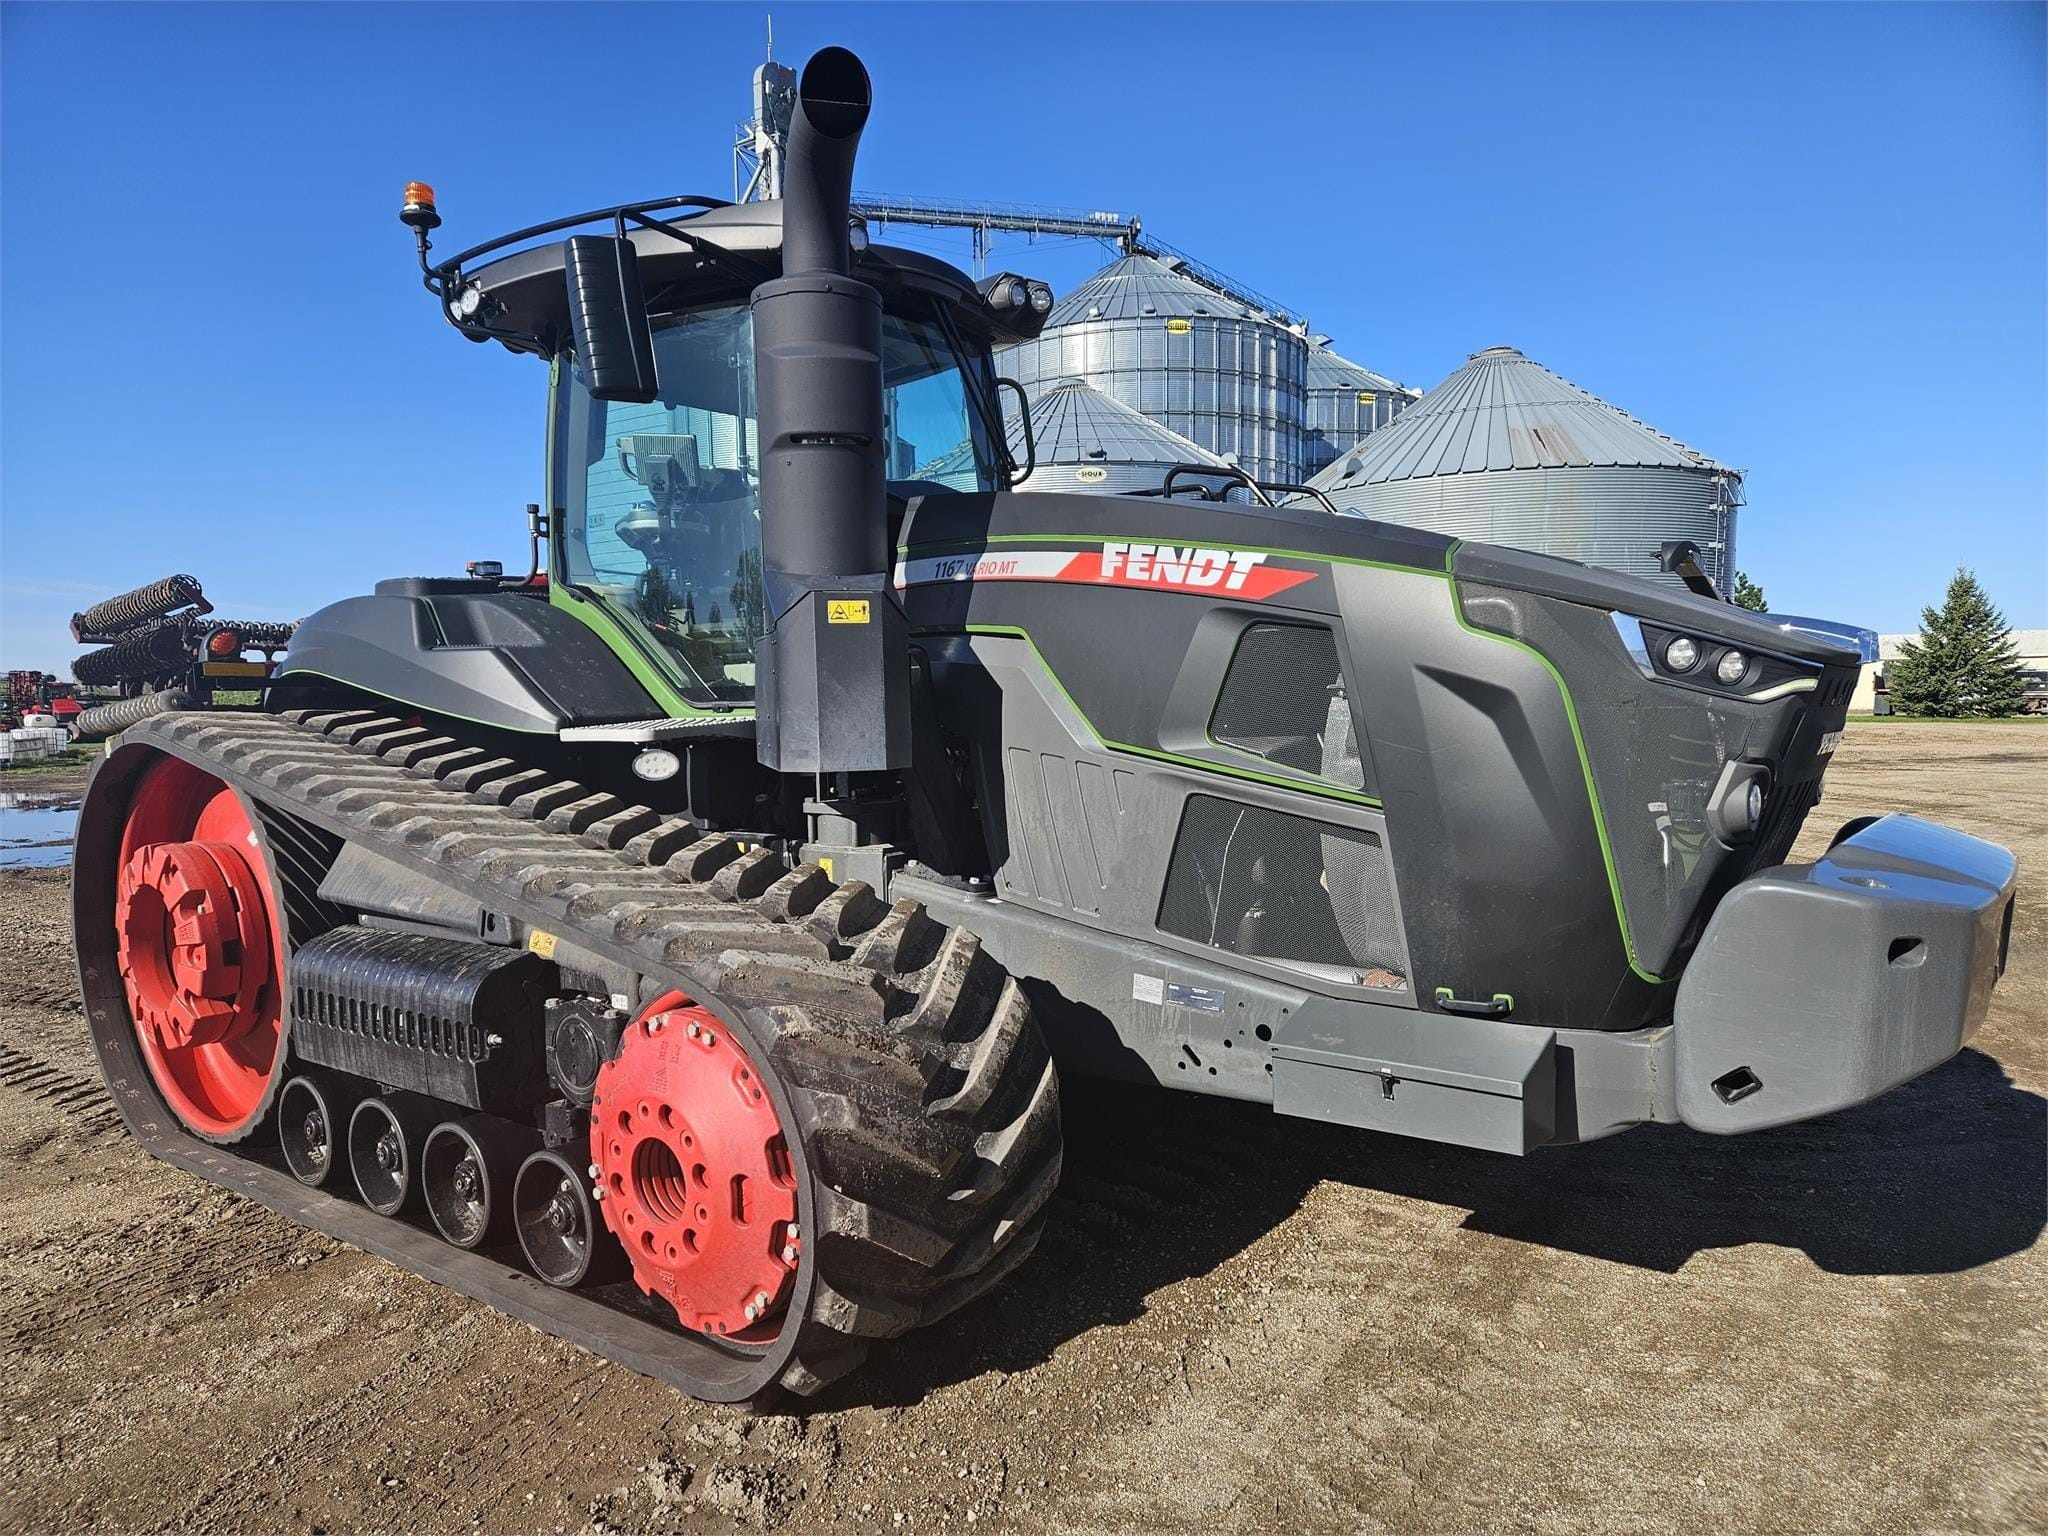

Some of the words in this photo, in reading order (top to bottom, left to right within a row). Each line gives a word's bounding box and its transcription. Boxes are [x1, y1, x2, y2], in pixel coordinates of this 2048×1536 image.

[935, 560, 964, 578] 1167
[965, 562, 997, 575] VARIO
[998, 561, 1018, 574] MT
[1101, 542, 1268, 590] FENDT
